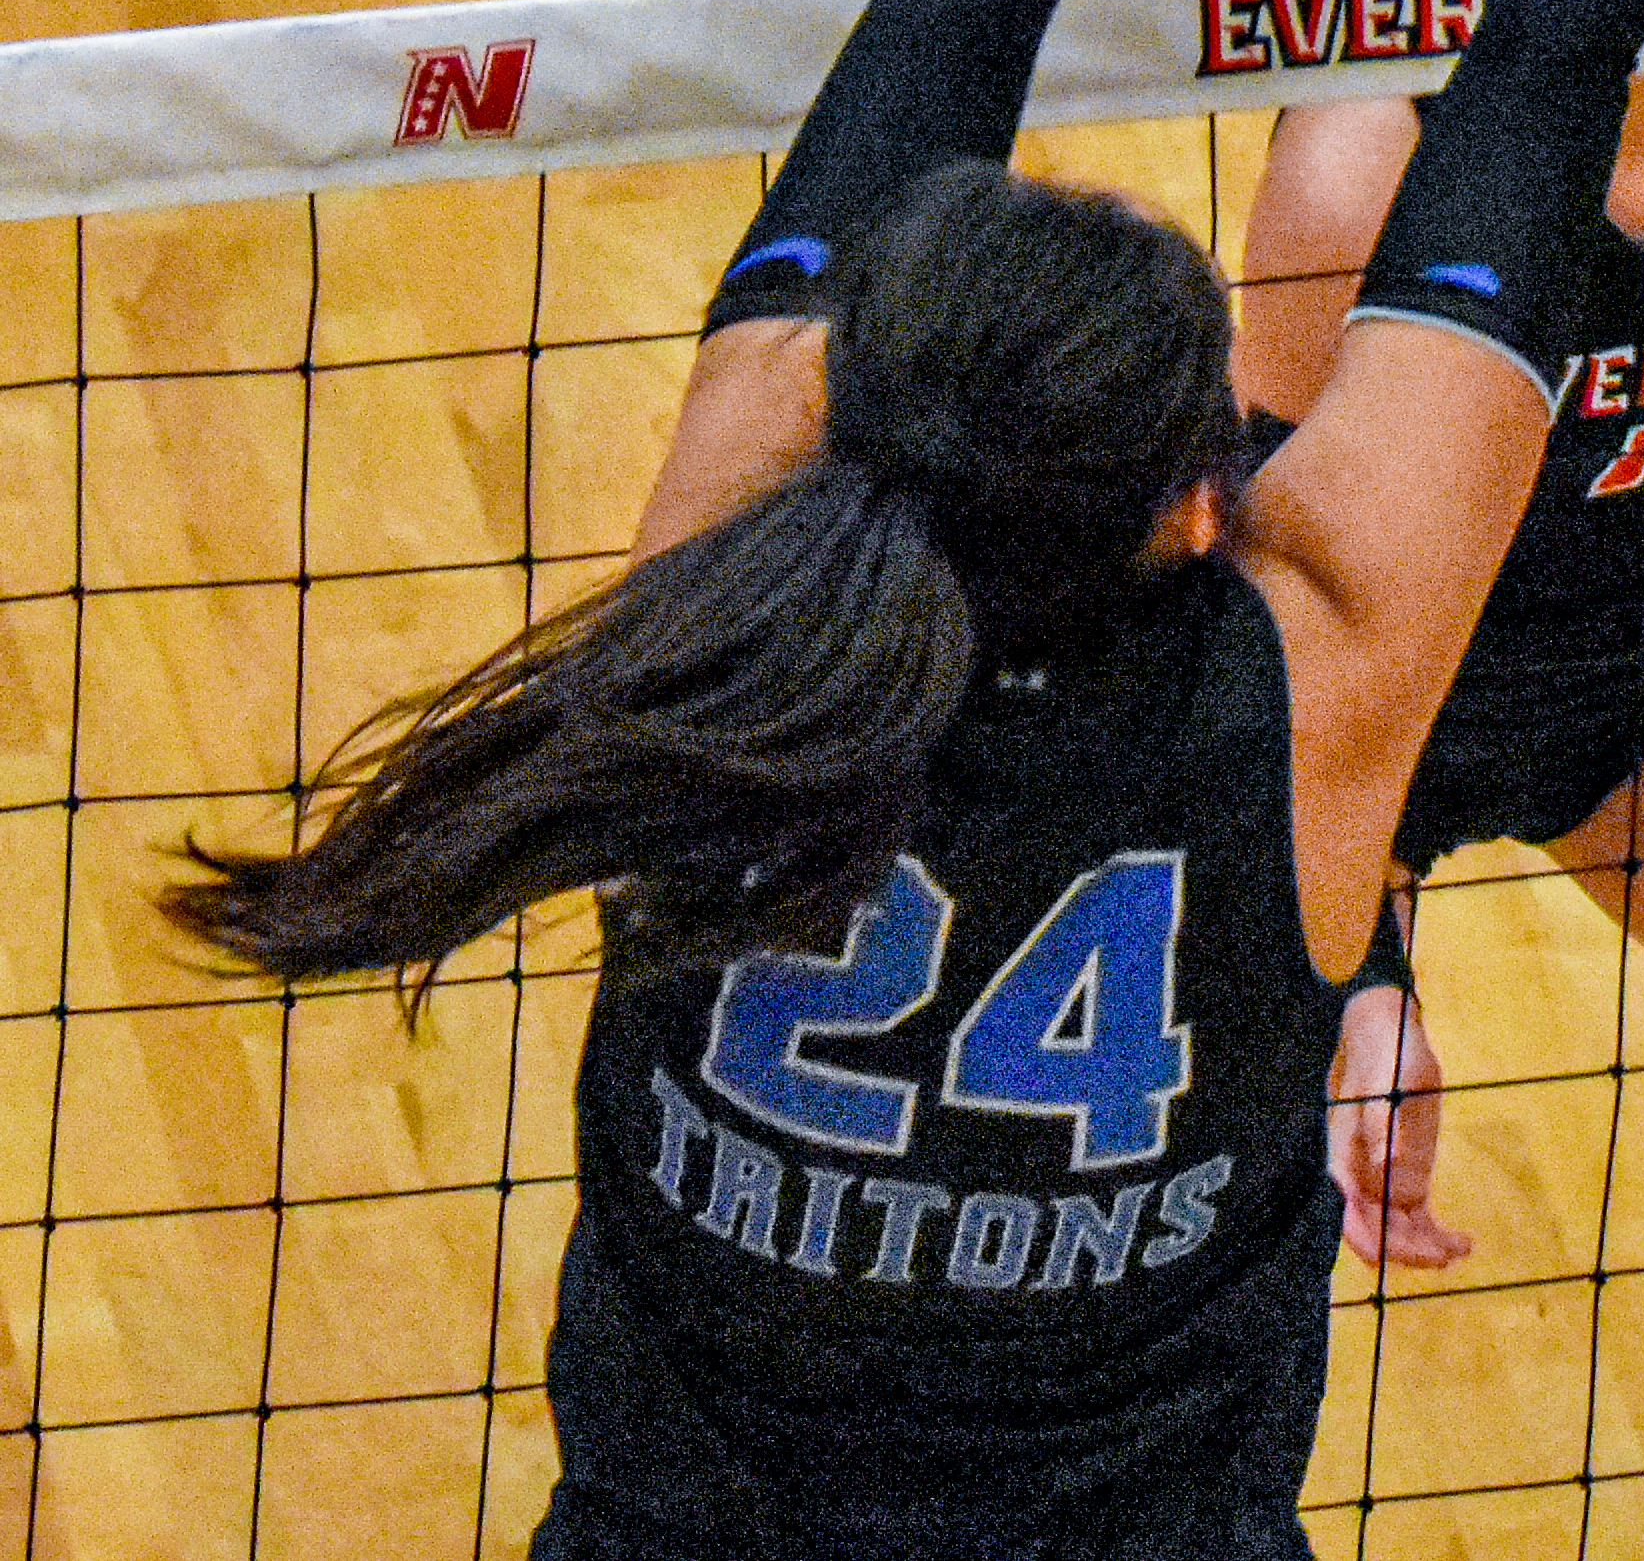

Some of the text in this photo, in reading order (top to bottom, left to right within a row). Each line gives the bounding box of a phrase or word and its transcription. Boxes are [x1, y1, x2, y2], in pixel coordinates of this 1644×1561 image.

[394, 38, 536, 146] N
[699, 848, 1191, 1172] 24
[648, 1067, 1235, 1293] TRITONS
